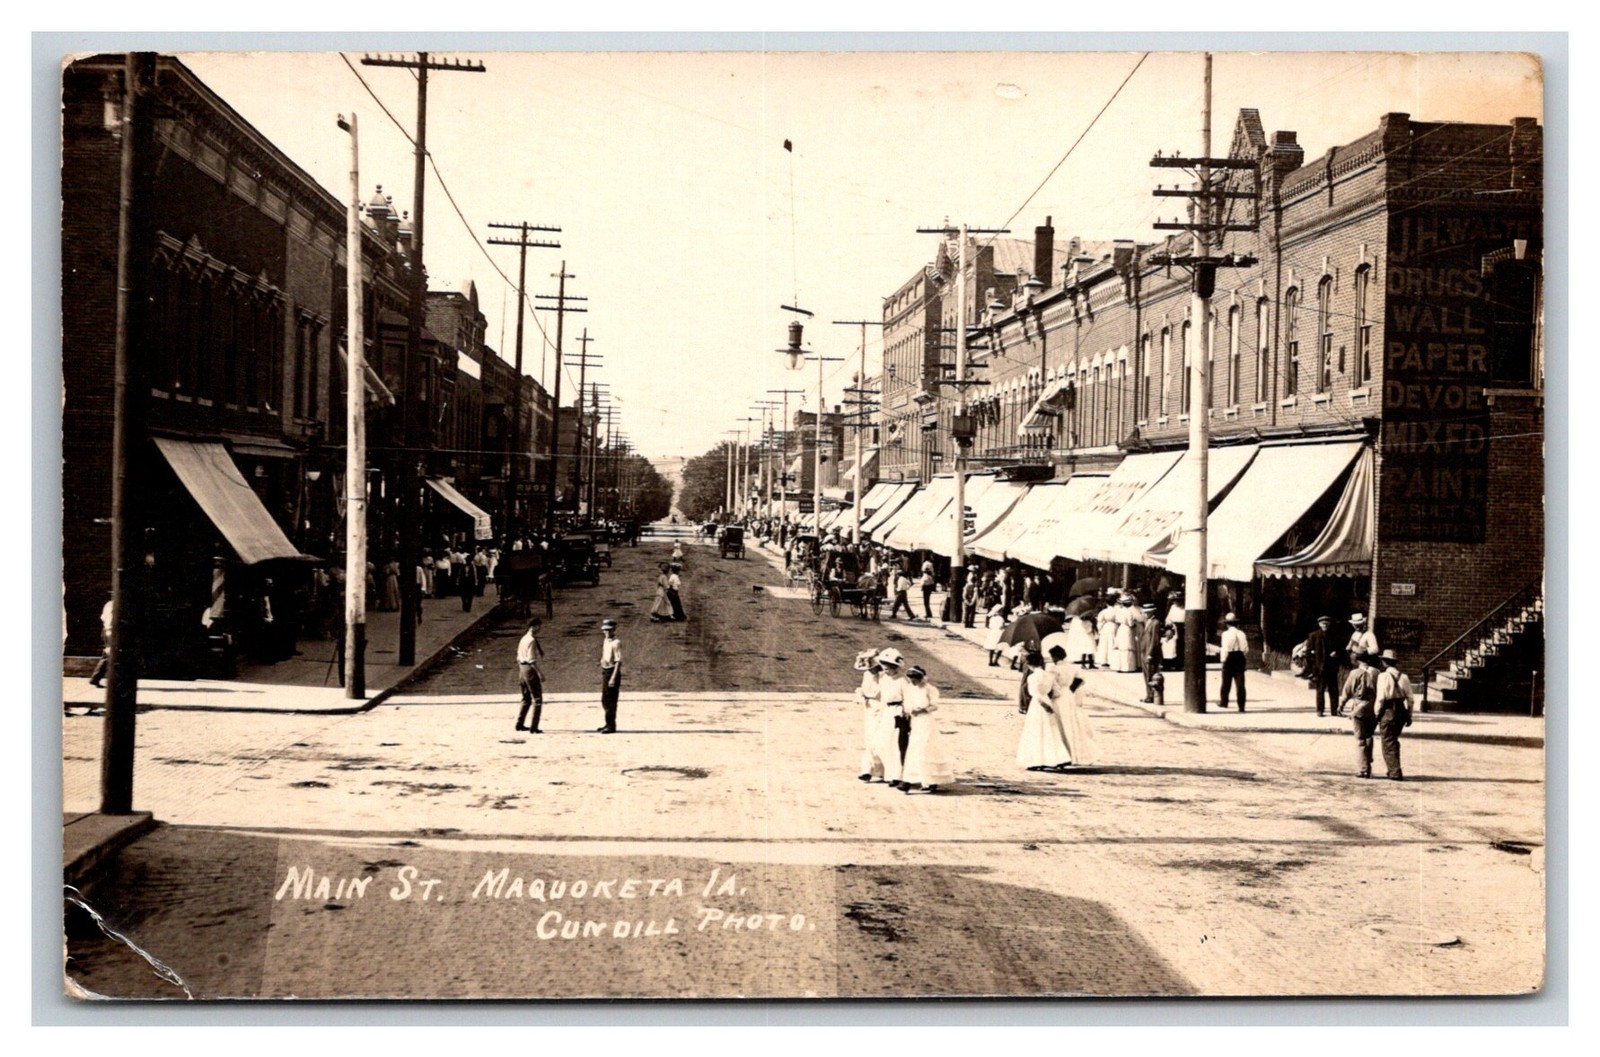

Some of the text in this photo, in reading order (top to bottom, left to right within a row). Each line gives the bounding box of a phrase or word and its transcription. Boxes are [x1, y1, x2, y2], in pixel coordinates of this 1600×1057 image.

[1393, 305, 1485, 335] WALL
[1387, 342, 1487, 373] PAPER
[1385, 379, 1482, 410] DEVOE
[1385, 421, 1484, 454] MIXED
